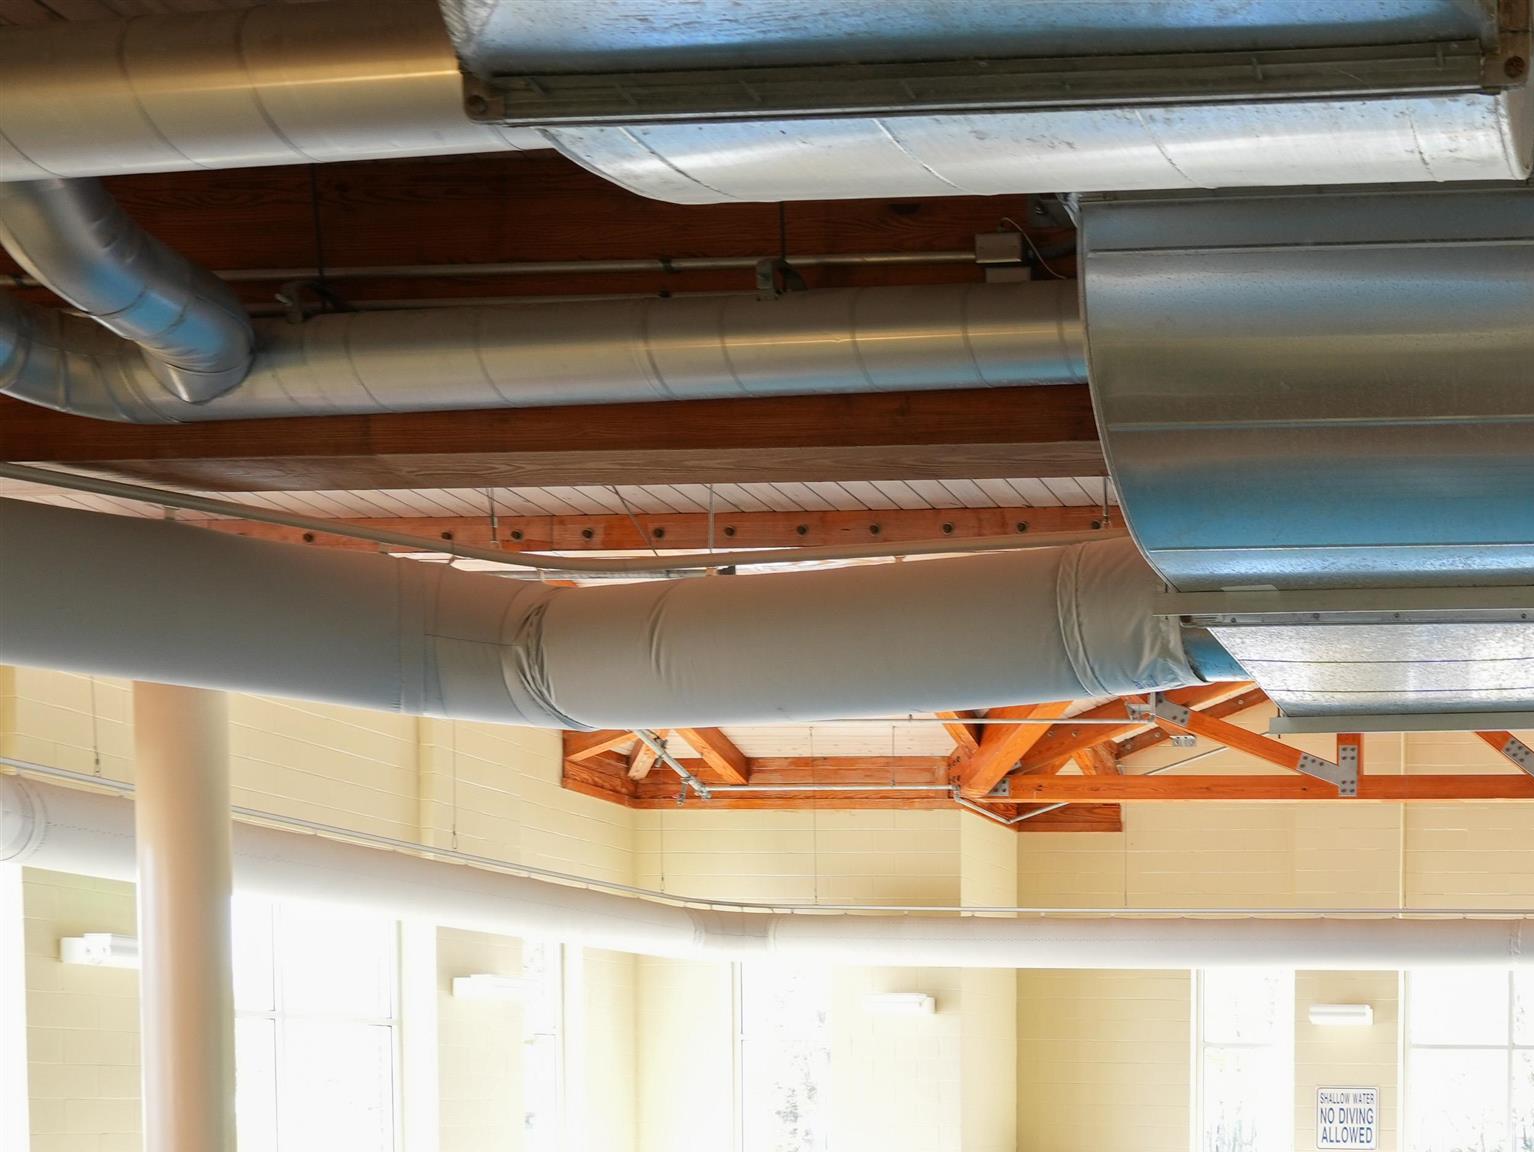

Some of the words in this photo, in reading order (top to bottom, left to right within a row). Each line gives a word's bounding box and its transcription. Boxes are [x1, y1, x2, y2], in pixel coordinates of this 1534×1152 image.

[1320, 1092, 1350, 1104] SHALLOW
[1353, 1092, 1374, 1104] WATER
[1320, 1107, 1334, 1124] NO
[1339, 1107, 1373, 1125] DIVING
[1321, 1126, 1373, 1143] ALLOWED
